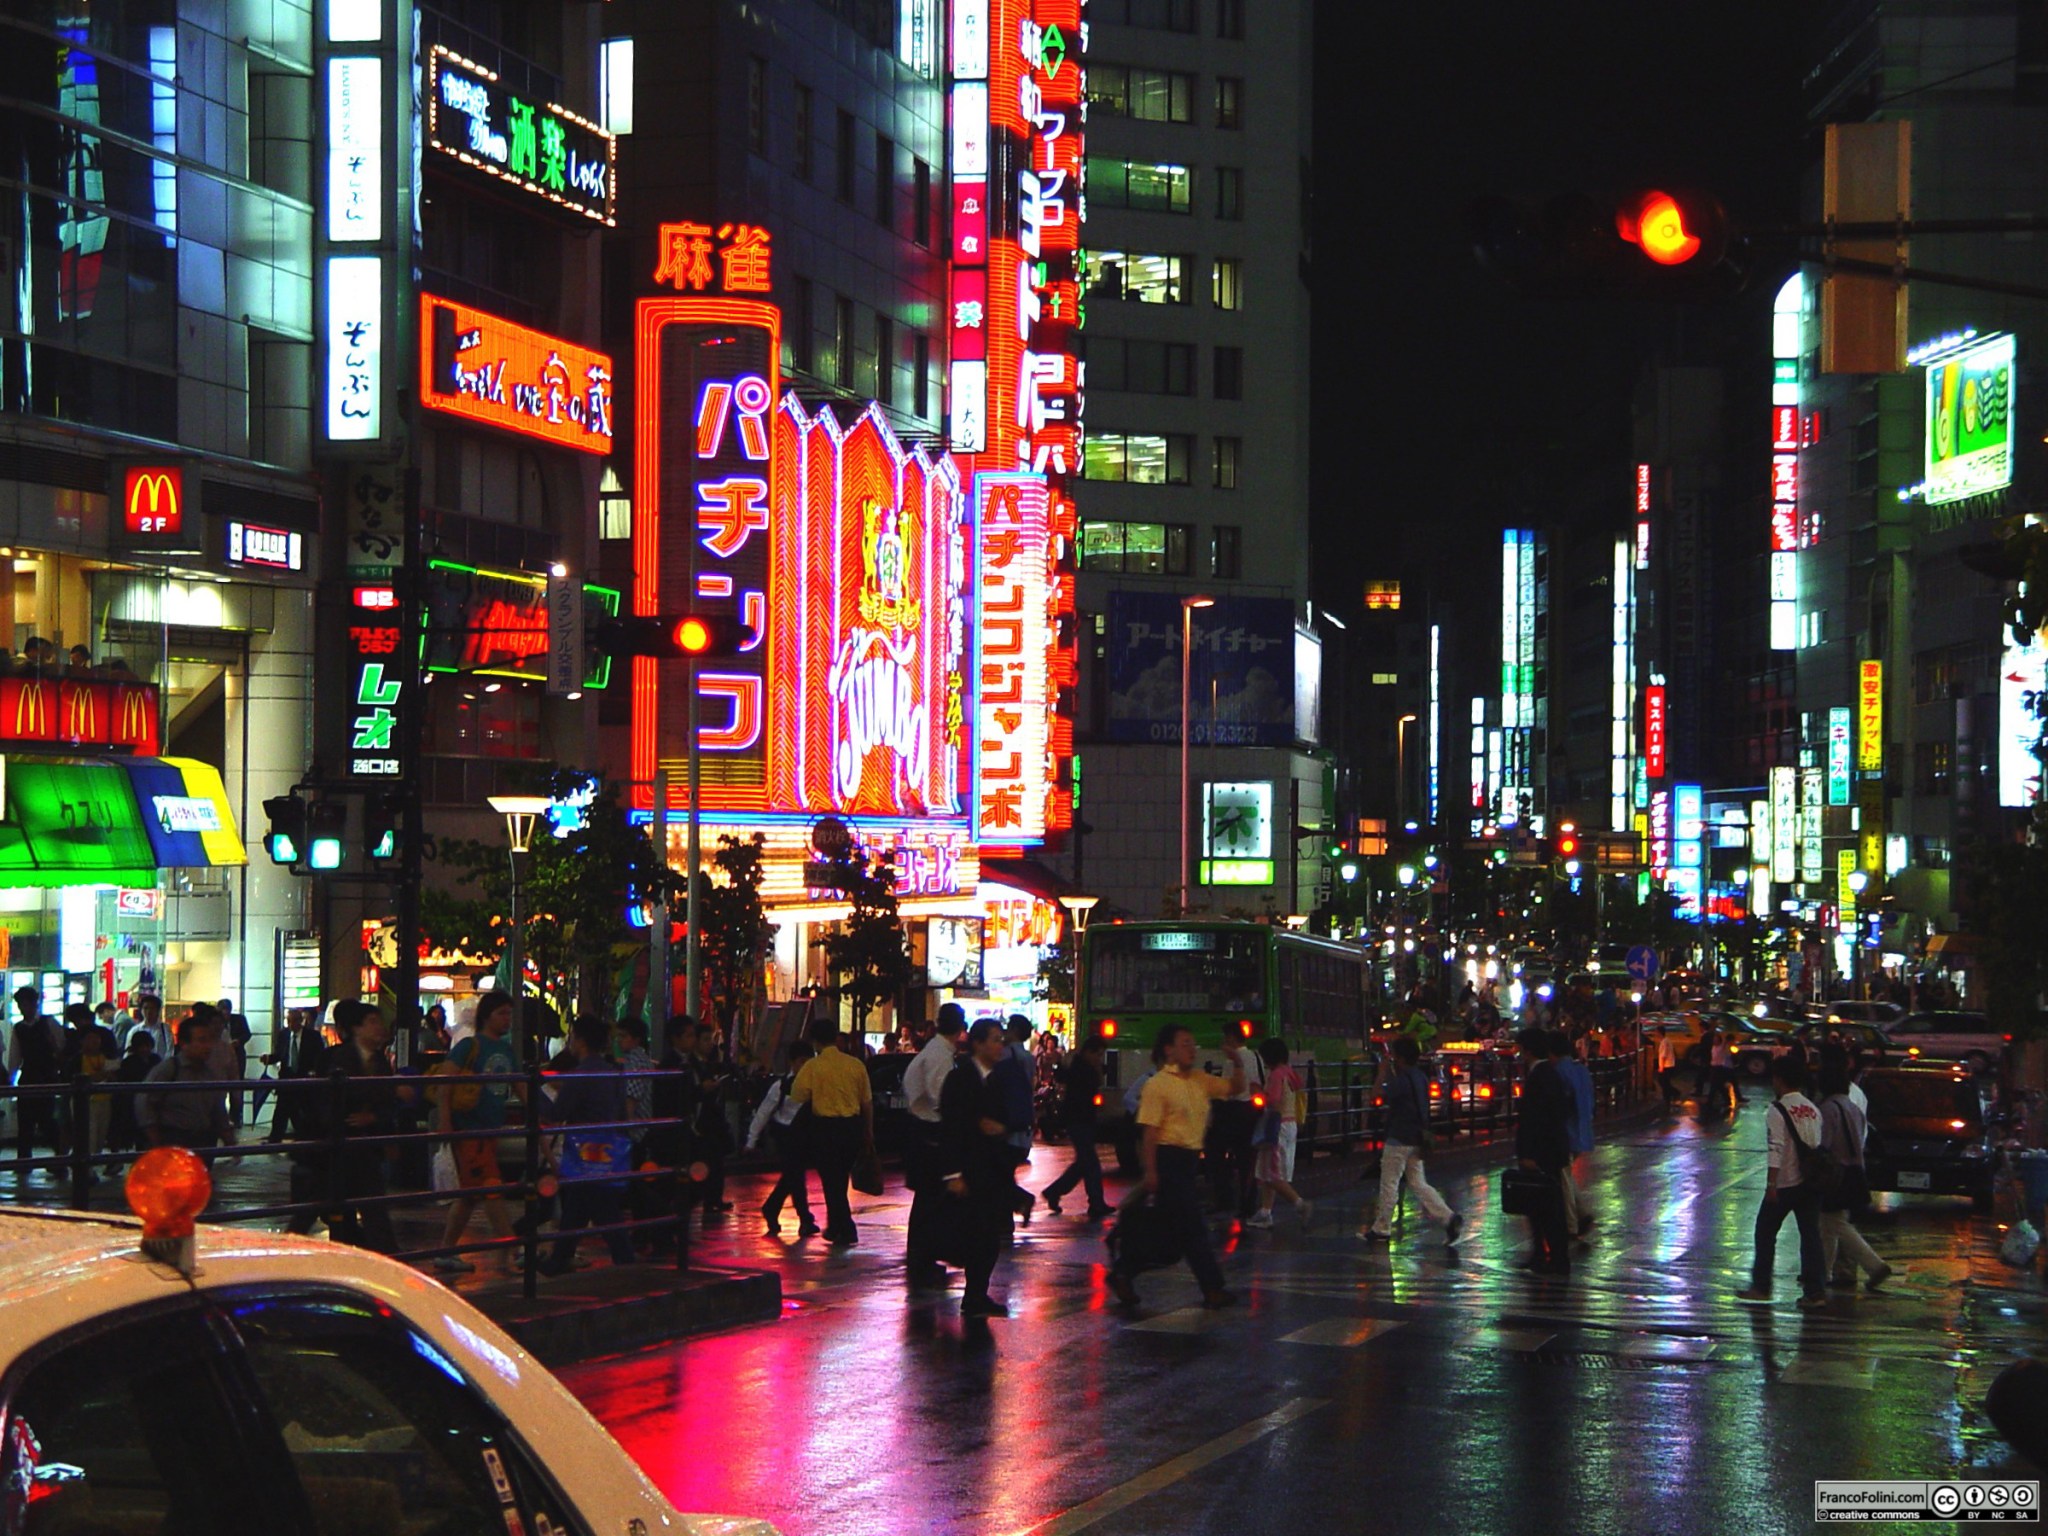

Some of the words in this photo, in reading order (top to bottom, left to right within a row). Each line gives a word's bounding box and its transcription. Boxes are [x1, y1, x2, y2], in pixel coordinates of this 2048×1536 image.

[1034, 113, 1067, 226] ワープロ
[654, 221, 772, 291] 麻雀
[140, 517, 166, 532] 2F
[697, 376, 771, 750] パチンコ
[984, 485, 1026, 829] パチンコジャンボ
[353, 663, 402, 749] レオ
[1650, 696, 1661, 767] モスバーガー
[1863, 664, 1879, 755] 激安チケット
